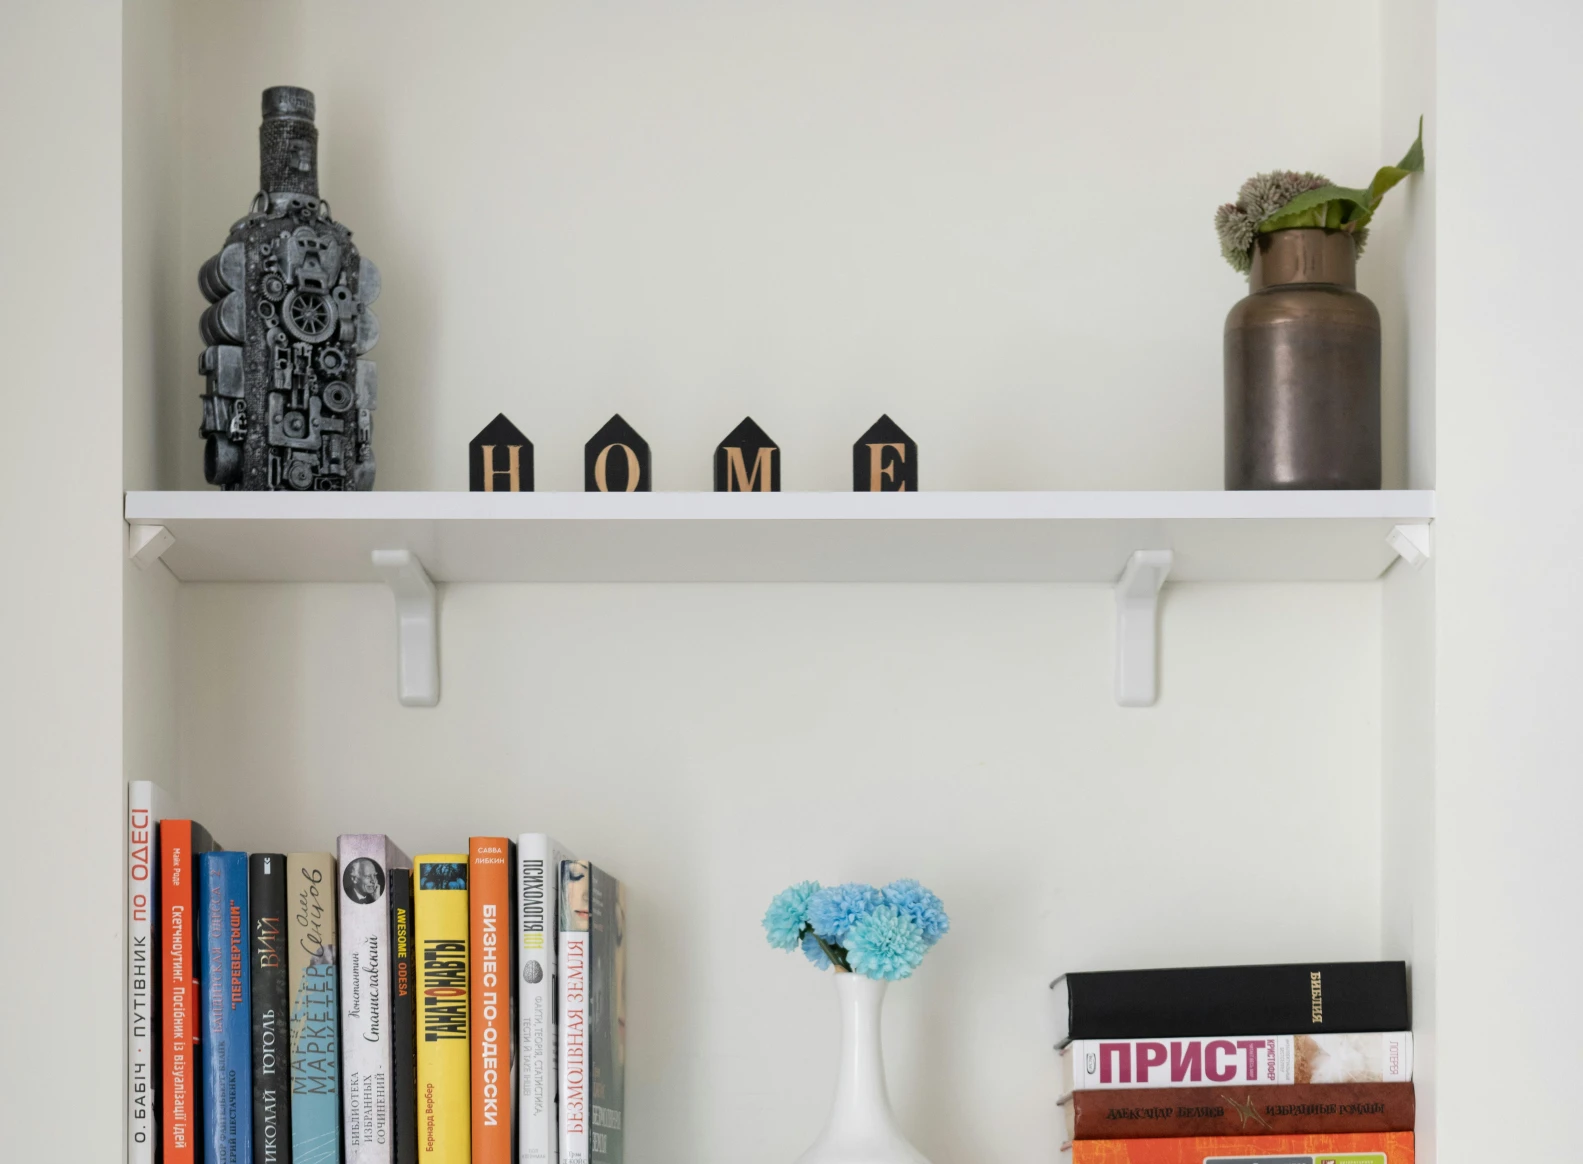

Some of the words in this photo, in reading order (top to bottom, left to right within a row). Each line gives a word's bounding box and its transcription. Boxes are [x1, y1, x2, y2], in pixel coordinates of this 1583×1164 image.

[131, 809, 149, 881] ОДЕСІ
[173, 848, 181, 867] Майк
[173, 868, 181, 886] Роде
[133, 895, 147, 921] ПО
[300, 868, 325, 958] Сенцов
[397, 908, 407, 958] AWESOME
[171, 905, 186, 983] Скетчноутинг.
[256, 917, 280, 969] ВИЙ
[483, 904, 497, 987] БИЗНЕС
[133, 936, 147, 1037] ПУТІВНИК
[347, 951, 360, 1018] Константин
[362, 934, 379, 1043] Станиславский
[397, 962, 407, 996] ODESA
[423, 939, 467, 1042] ТАНАТОНАВТЫ
[567, 940, 584, 1002] ЗЕМЛЯ
[1310, 971, 1322, 1024] БИБЛИЯ
[172, 987, 186, 1039] Посібник
[306, 966, 327, 1095] МАРКЕТЕР
[522, 1017, 532, 1042] ТЕСТИ
[173, 1041, 185, 1051] із
[262, 1009, 276, 1075] ГОГОЛЬ
[482, 992, 498, 1126] ПО-ОДЕССКИ
[522, 1055, 531, 1072] ТАКЕ
[1098, 1040, 1267, 1084] ПРИСТ
[1267, 1039, 1276, 1081] КРИСТОФЕР
[1389, 1041, 1399, 1076] ЛОТЕРЕЯ
[134, 1062, 146, 1119] БАБІЧ
[171, 1054, 187, 1121] візуалізації
[425, 1083, 435, 1113] Вербер
[566, 1009, 584, 1135] БЕЗМОЛВНАЯ
[229, 1069, 237, 1136] ШЕСТАЧЕНКО
[350, 1071, 360, 1146] БИБЛИОТЕКА
[363, 1074, 373, 1142] ИЗБРАННЫХ
[374, 1072, 386, 1145] СОЧИНЕНИЙ
[1105, 1107, 1174, 1121] АЛЕКСАНДР
[1177, 1106, 1225, 1119] БЕЛЯЕВ
[1265, 1103, 1337, 1117] ИЗБРАННЫЕ
[1338, 1102, 1385, 1115] РОМАНЫ
[135, 1125, 146, 1143] О.
[172, 1123, 187, 1148] ідей
[426, 1115, 435, 1152] Бернард
